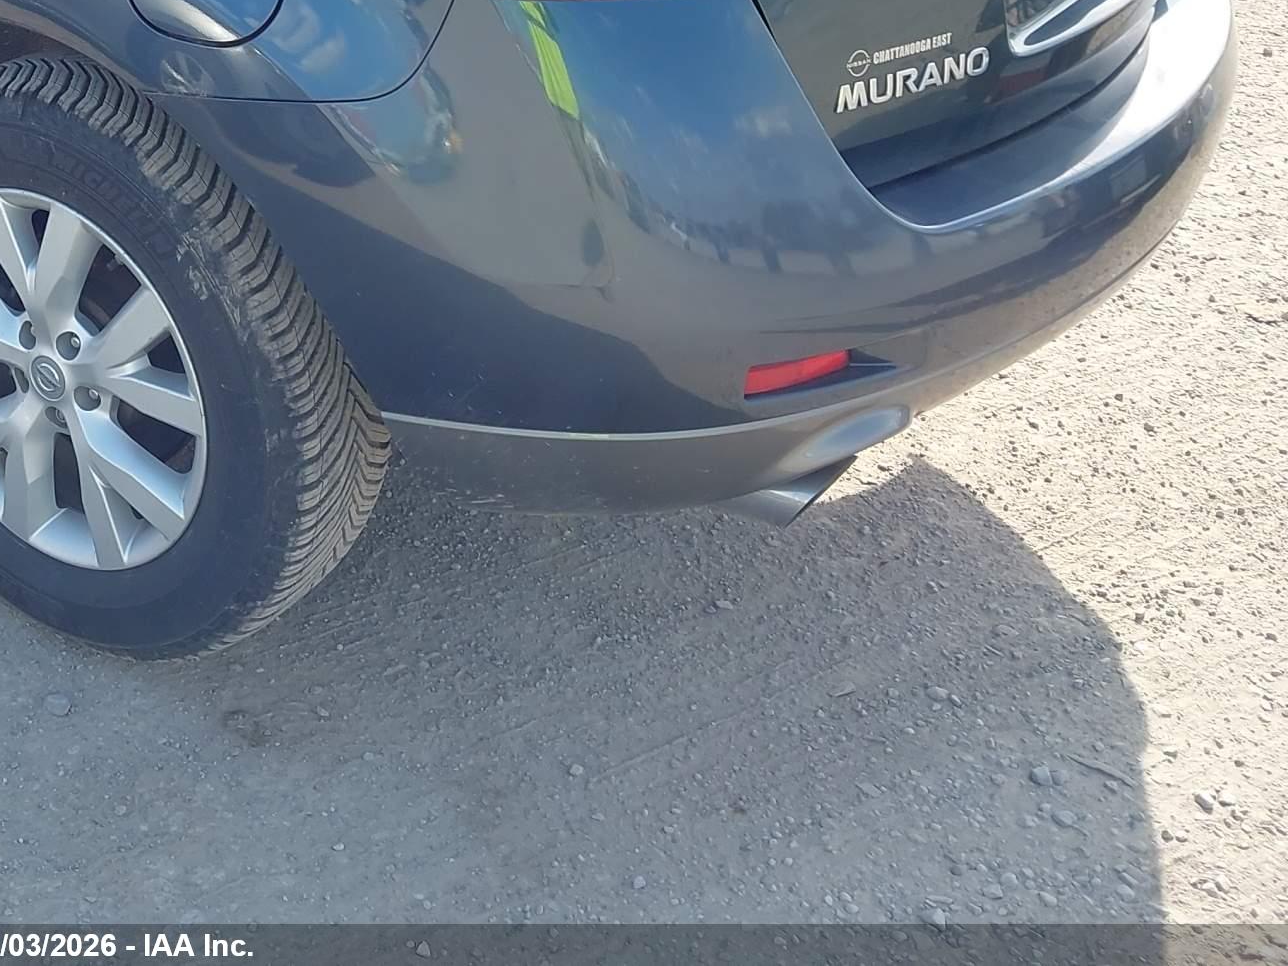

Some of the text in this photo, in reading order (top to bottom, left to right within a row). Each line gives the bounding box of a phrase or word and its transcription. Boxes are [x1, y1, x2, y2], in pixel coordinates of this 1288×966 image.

[873, 39, 931, 65] CHATTANOOGA
[932, 32, 952, 49] EAST
[836, 46, 990, 114] MURANO
